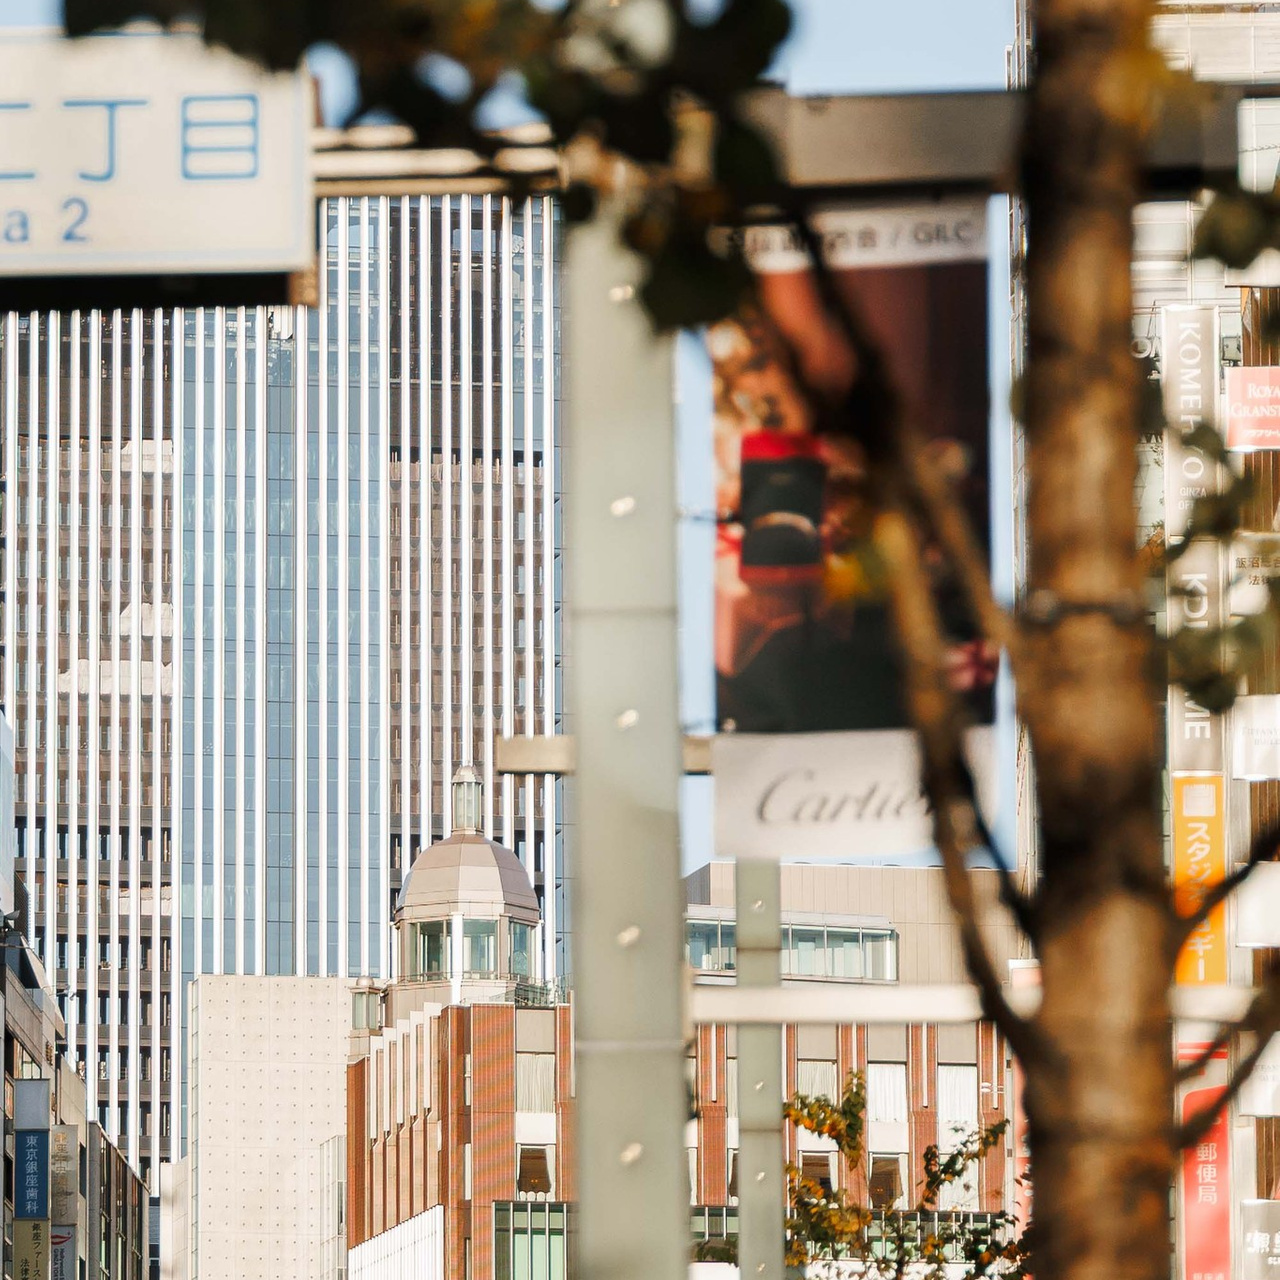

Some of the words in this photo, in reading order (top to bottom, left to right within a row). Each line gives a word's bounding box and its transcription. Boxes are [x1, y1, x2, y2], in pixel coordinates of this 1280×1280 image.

[62, 197, 93, 244] 2
[1178, 322, 1204, 479] KOMEHO
[756, 765, 934, 826] Cartie
[25, 1135, 38, 1213] 東京銀座歯科
[1196, 1142, 1218, 1206] 郵便局
